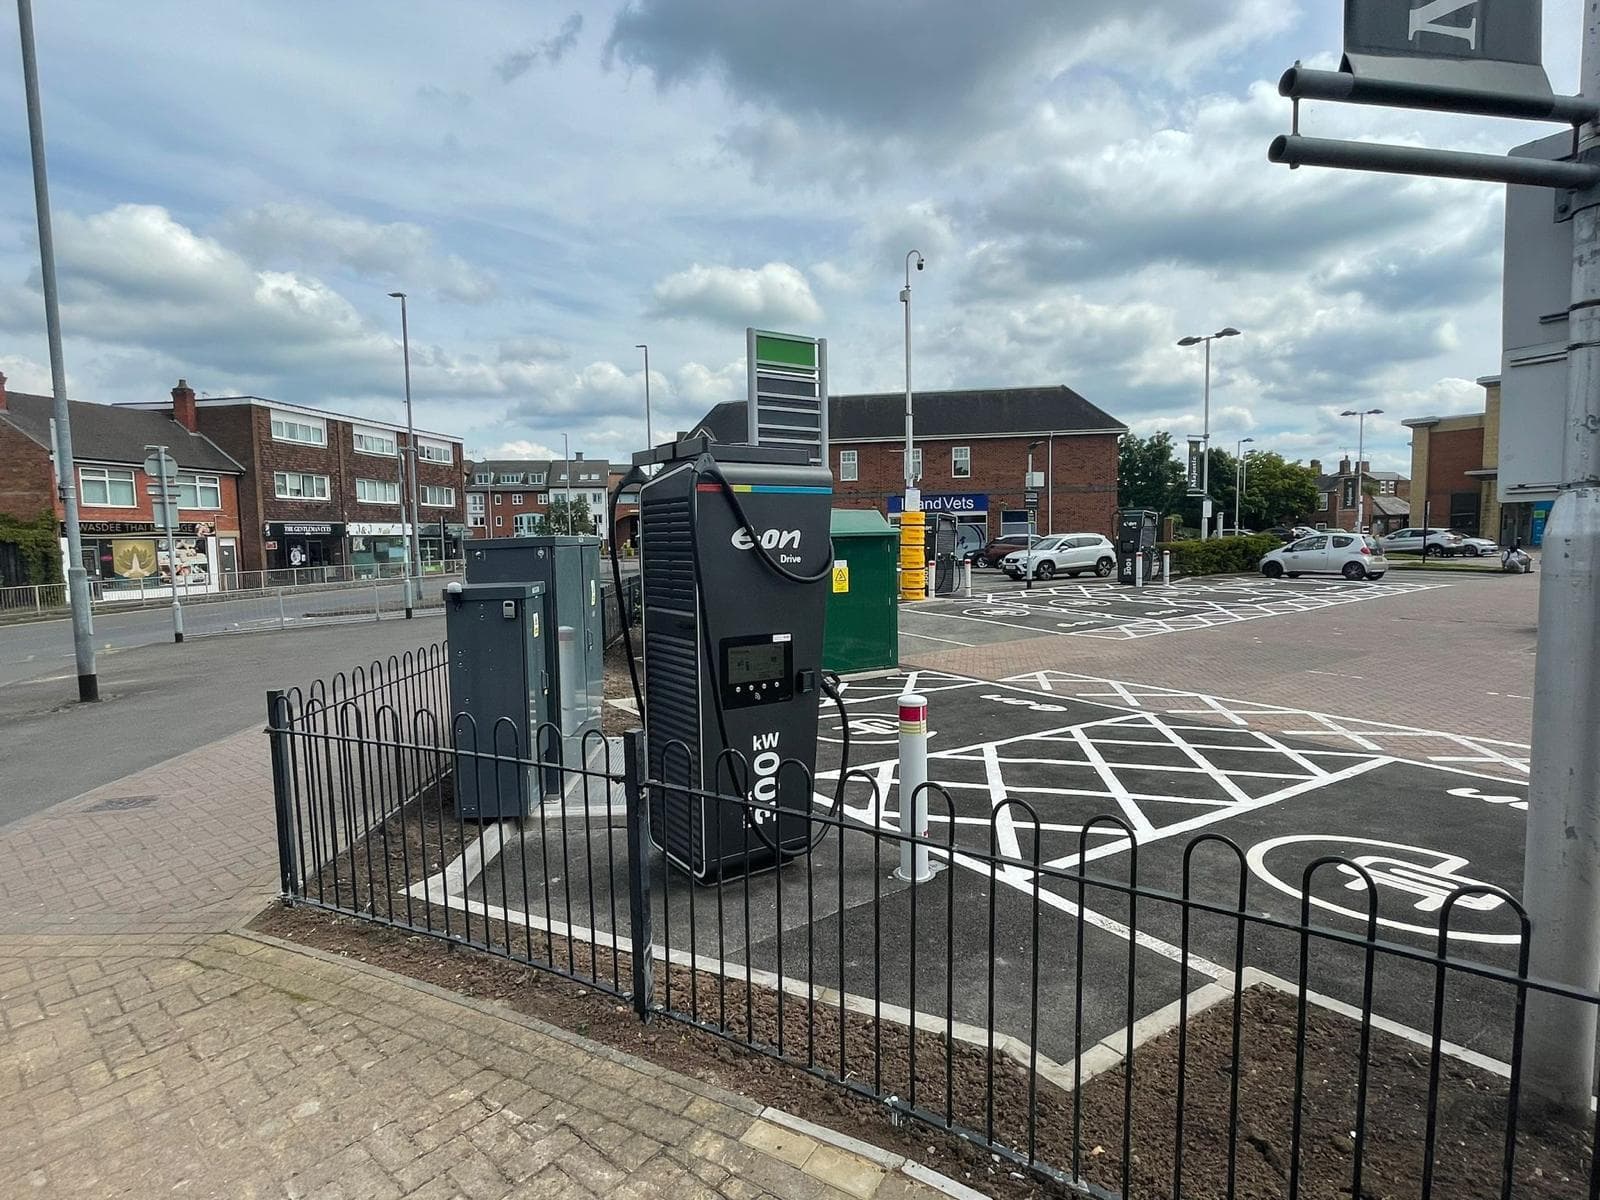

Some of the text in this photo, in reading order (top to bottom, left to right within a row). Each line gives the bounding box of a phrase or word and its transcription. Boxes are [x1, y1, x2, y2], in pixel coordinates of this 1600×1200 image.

[1190, 456, 1198, 488] Majestic
[901, 497, 942, 510] Iand
[943, 496, 974, 509] Vets
[126, 523, 147, 532] THAI
[780, 554, 802, 564] Drive
[752, 731, 780, 752] kW
